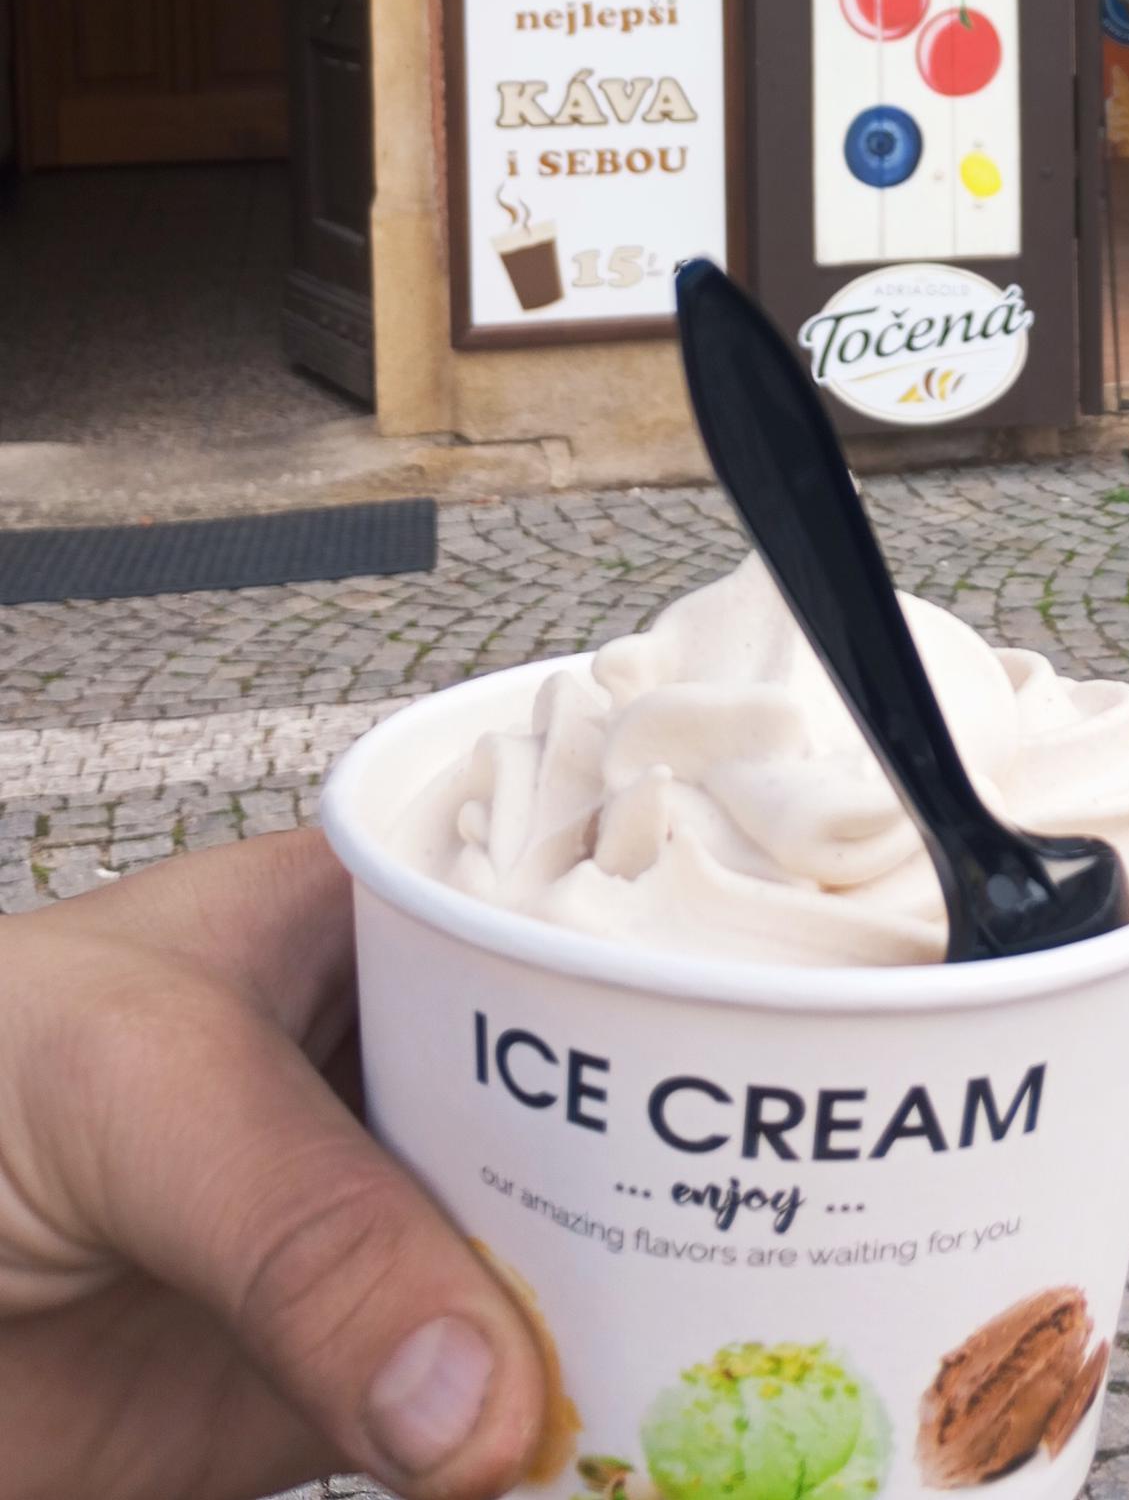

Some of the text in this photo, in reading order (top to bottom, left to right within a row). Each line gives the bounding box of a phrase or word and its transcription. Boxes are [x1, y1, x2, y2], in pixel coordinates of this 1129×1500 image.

[496, 68, 698, 128] KÁVA
[507, 146, 688, 177] i SEBOU
[805, 289, 1026, 378] Točená
[474, 1010, 1047, 1163] ICE CREAM
[480, 1165, 1021, 1267] our amazing flavors are waiting for you
[671, 1177, 806, 1233] enjoy
